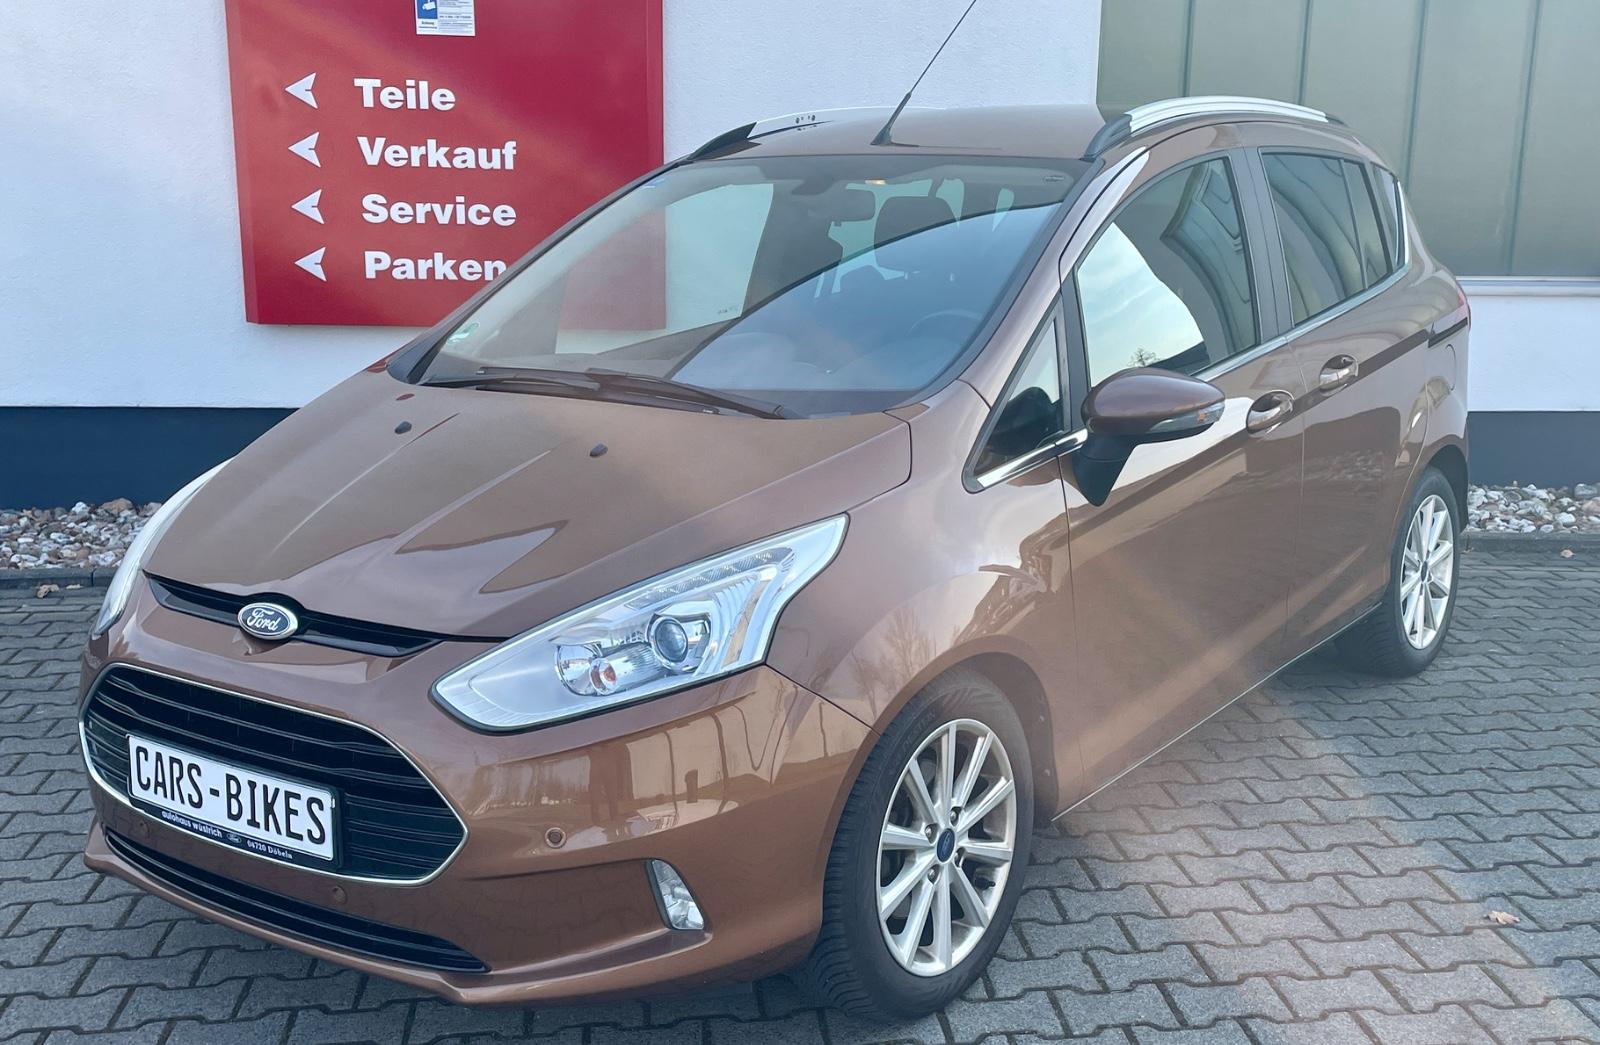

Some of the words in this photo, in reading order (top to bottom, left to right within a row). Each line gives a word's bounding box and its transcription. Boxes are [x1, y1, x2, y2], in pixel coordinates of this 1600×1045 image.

[354, 78, 456, 111] Teile
[357, 136, 517, 170] Verkauf
[361, 193, 517, 227] Service
[364, 250, 507, 281] Parken
[246, 607, 282, 631] Ford
